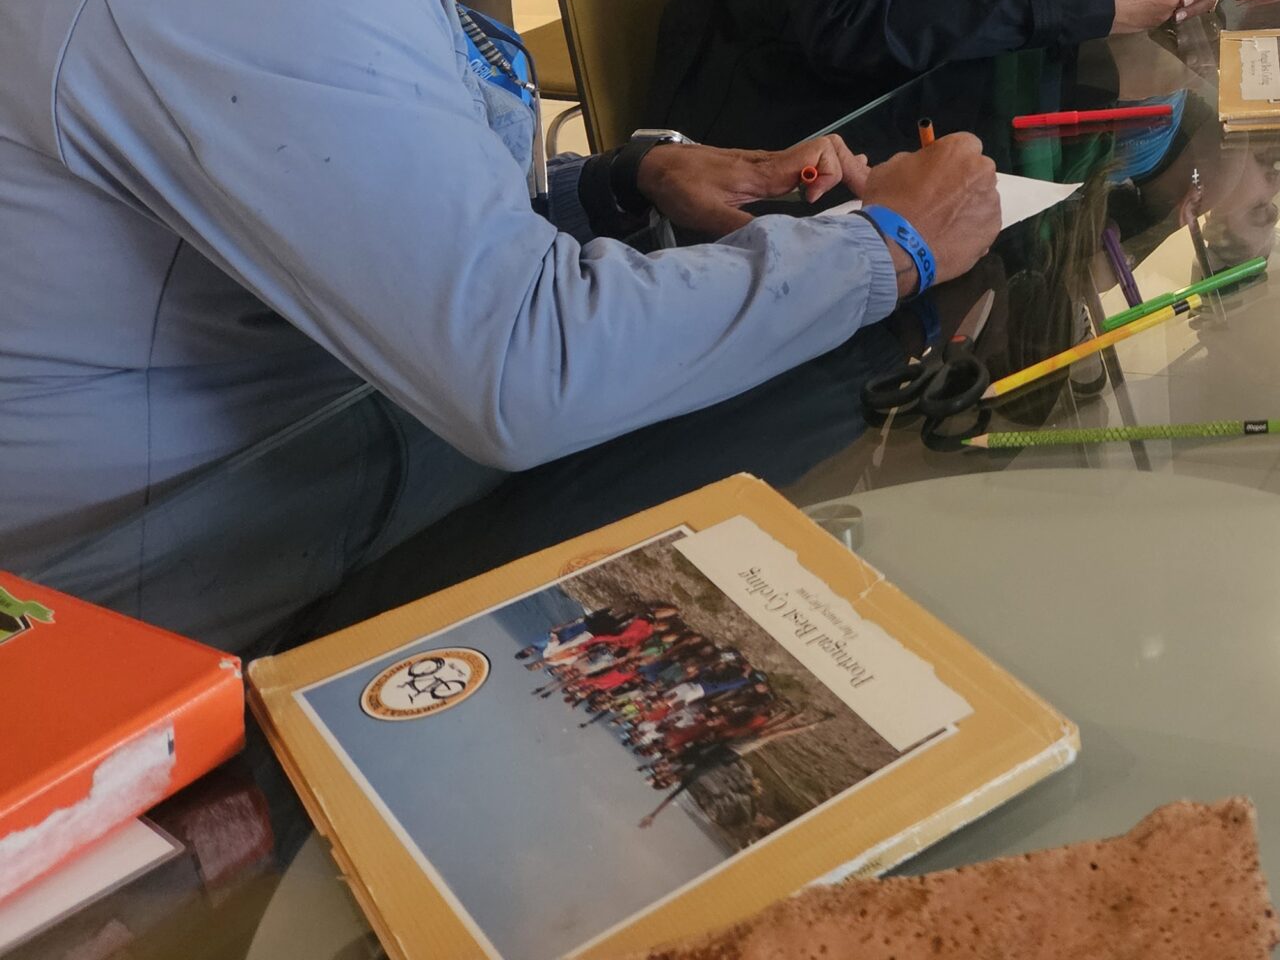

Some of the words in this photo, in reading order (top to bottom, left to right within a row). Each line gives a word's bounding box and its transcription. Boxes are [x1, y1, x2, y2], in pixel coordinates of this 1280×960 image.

[737, 566, 789, 611] Cycling
[782, 608, 818, 639] Best
[805, 634, 875, 688] Portugal
